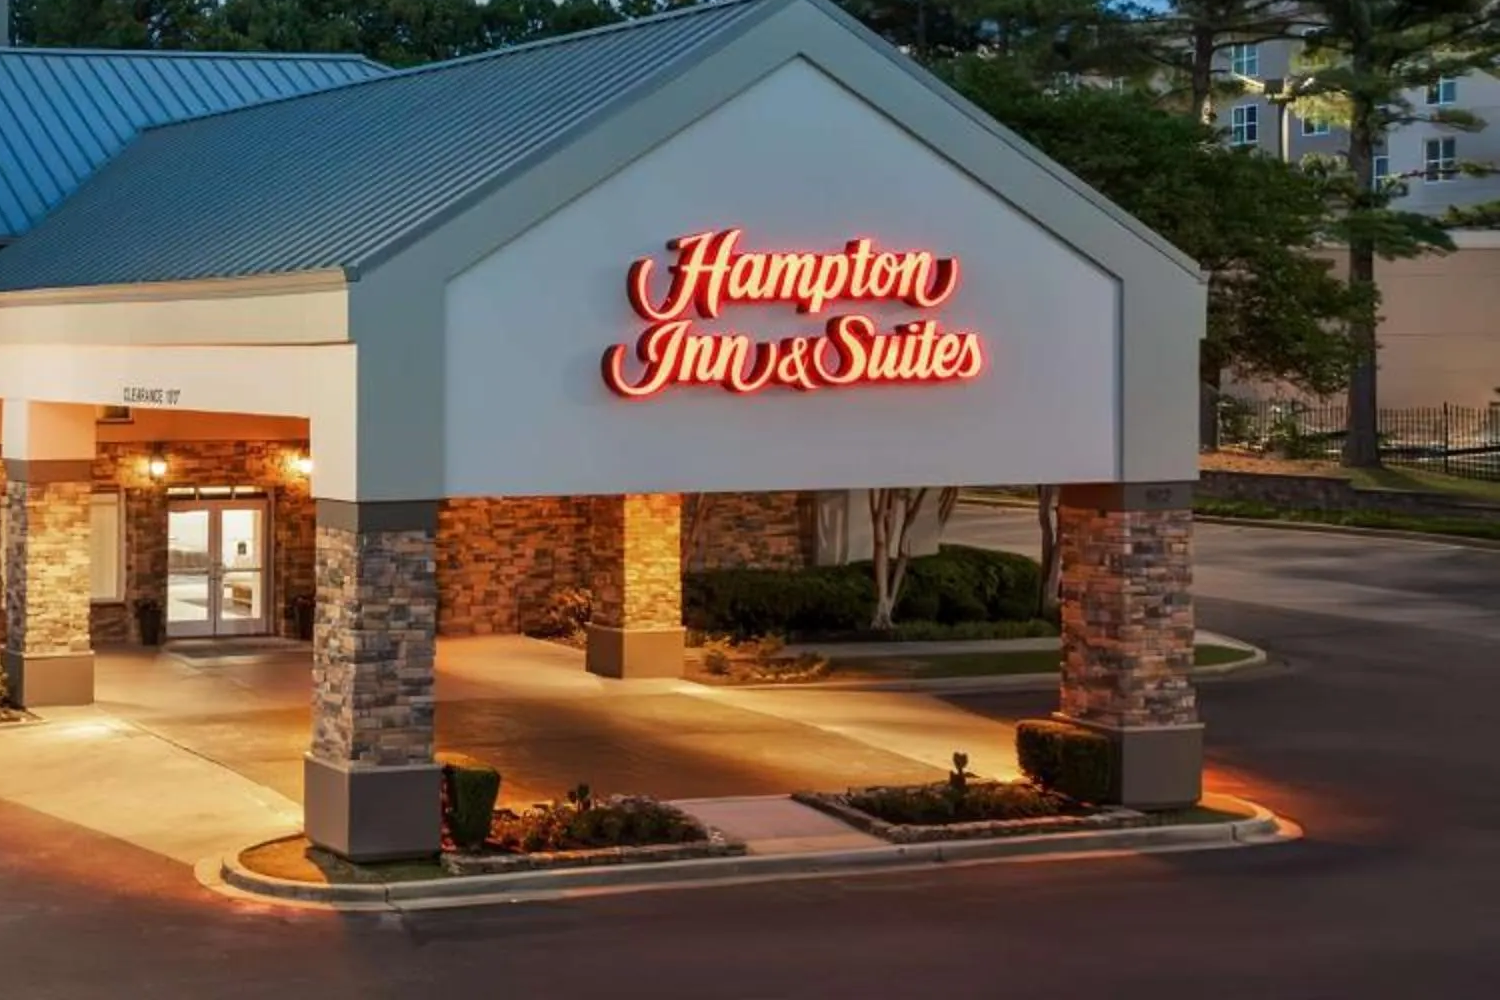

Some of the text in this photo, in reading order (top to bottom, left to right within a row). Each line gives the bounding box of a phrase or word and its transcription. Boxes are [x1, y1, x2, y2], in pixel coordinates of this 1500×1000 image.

[629, 229, 958, 319] Hampton
[604, 315, 983, 396] Inn & Suites
